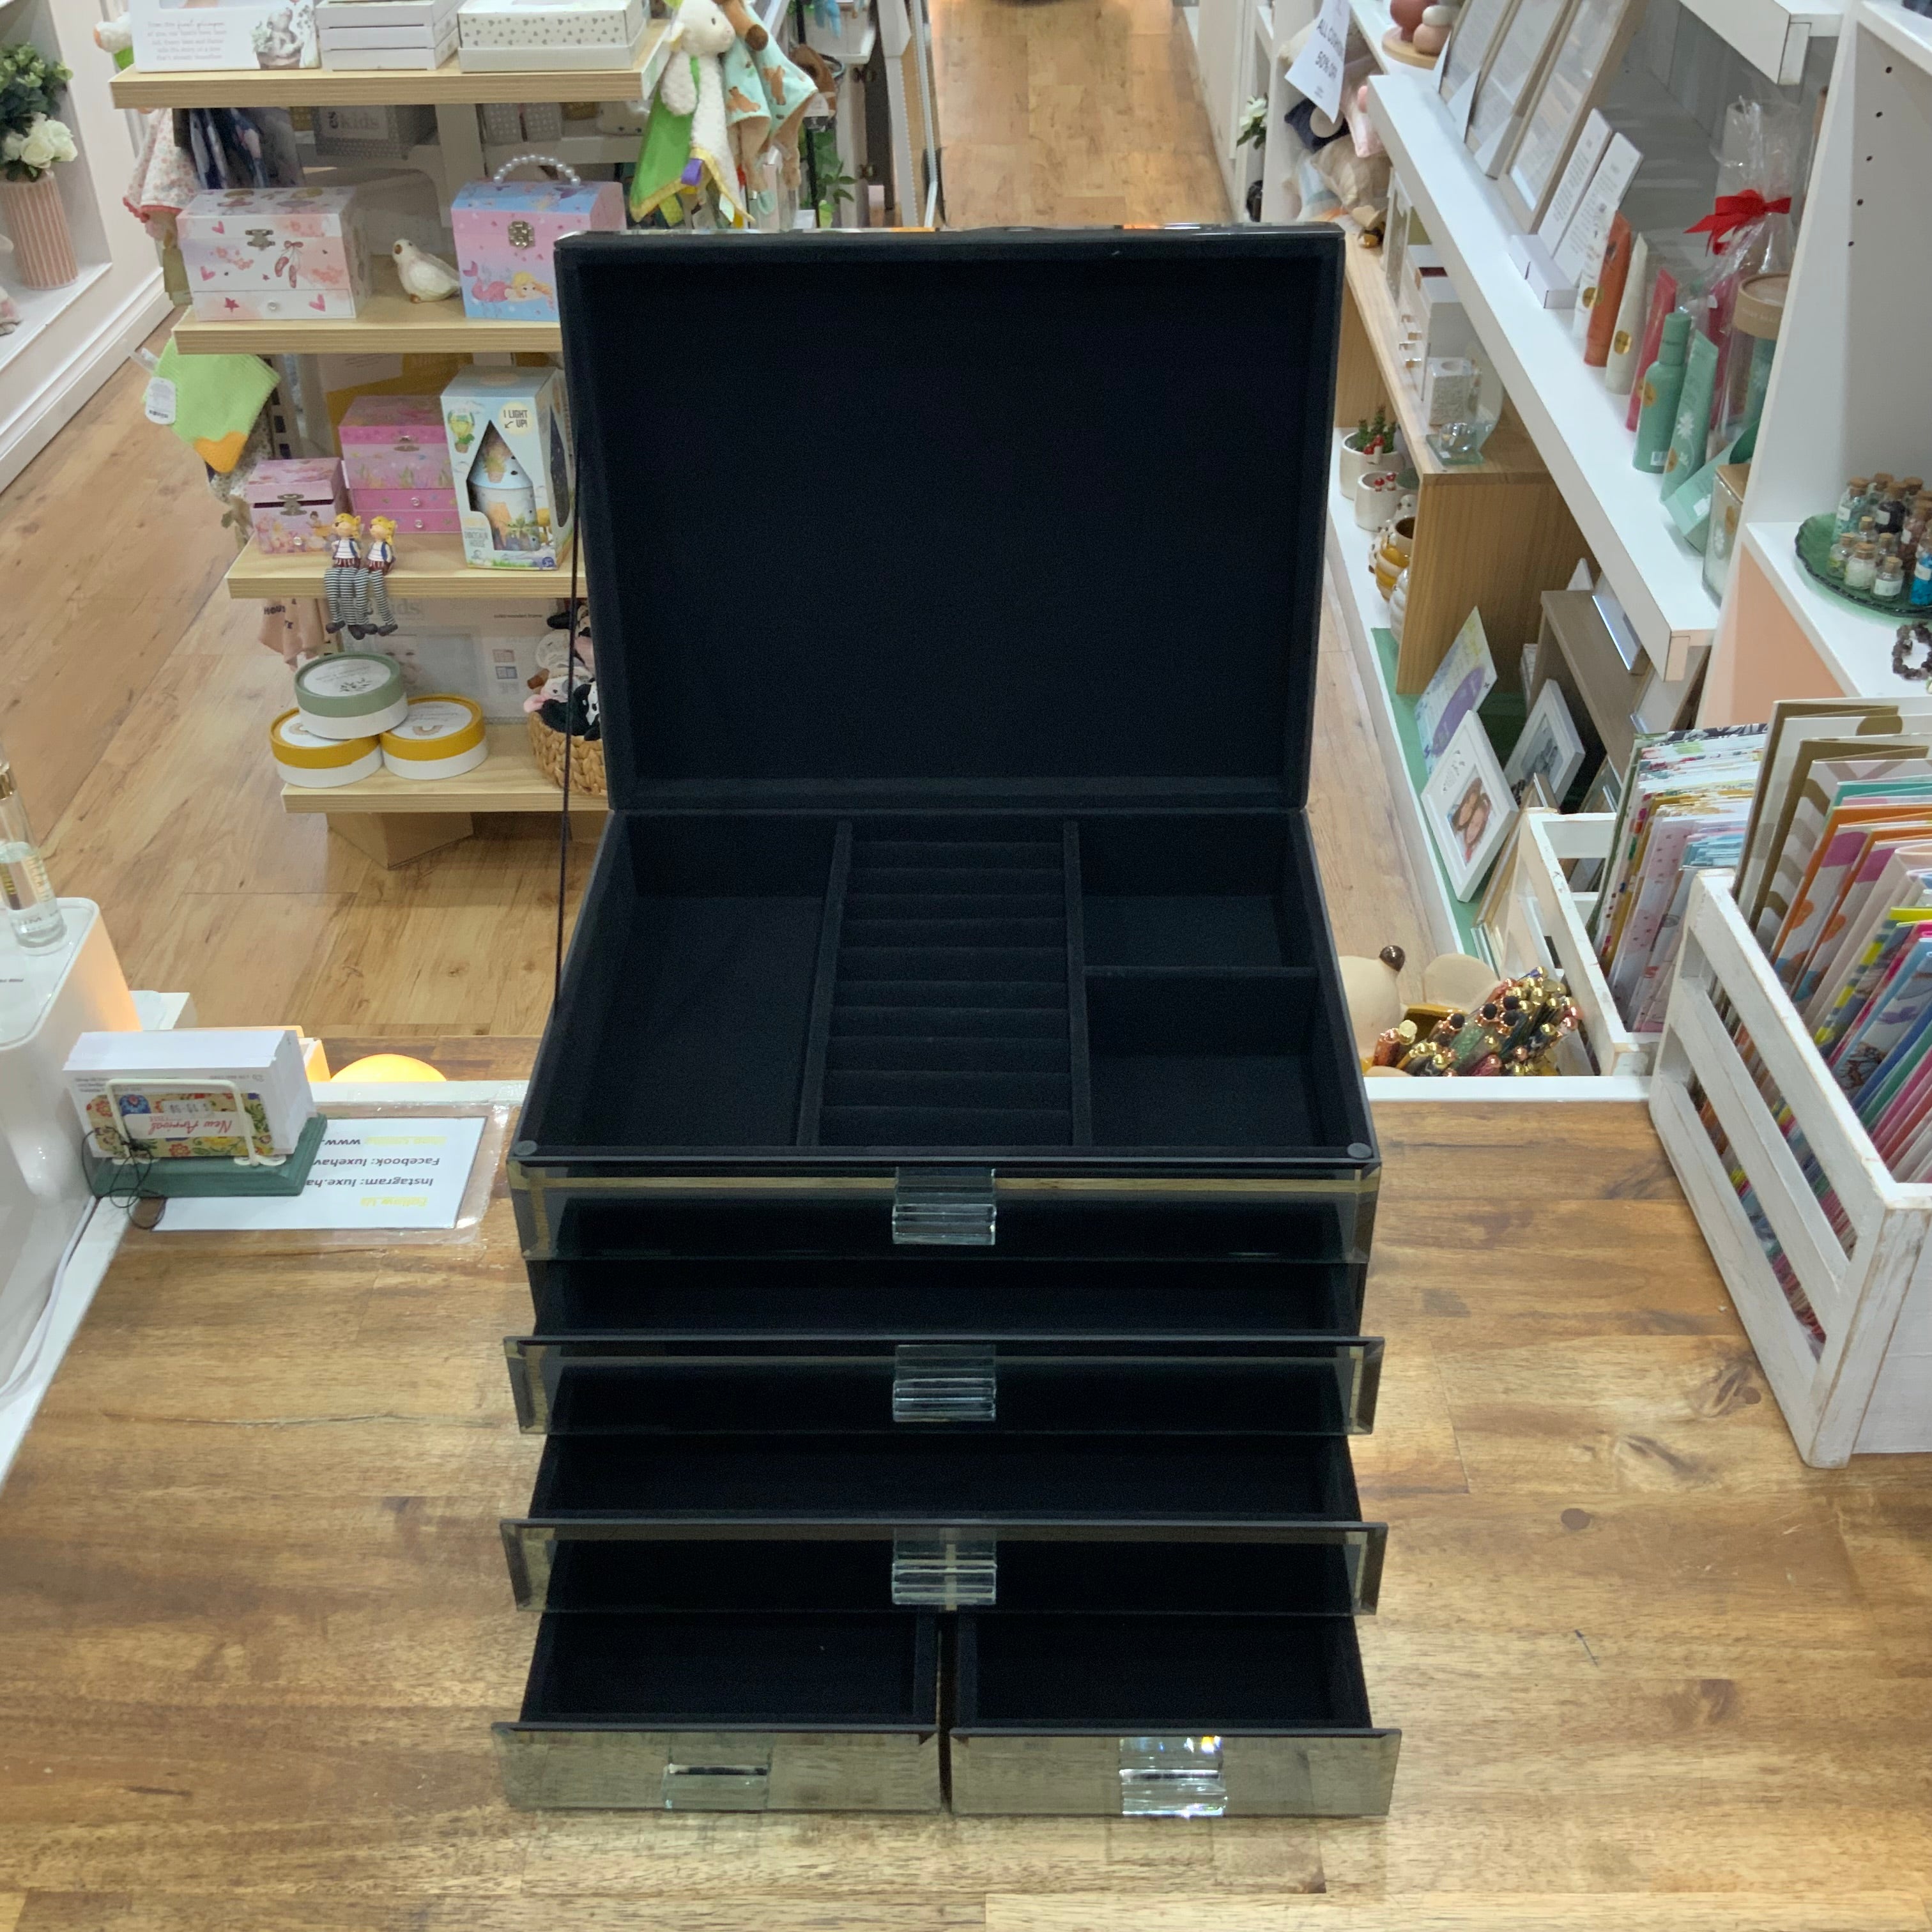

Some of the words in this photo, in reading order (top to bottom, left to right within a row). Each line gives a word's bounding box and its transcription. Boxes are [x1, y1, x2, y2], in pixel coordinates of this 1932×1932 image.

[508, 410, 528, 419] LIGHT
[148, 1119, 199, 1135] Arrival
[204, 1120, 233, 1134] New
[371, 1157, 441, 1167] Facebook:
[360, 1177, 434, 1187] Instagram:
